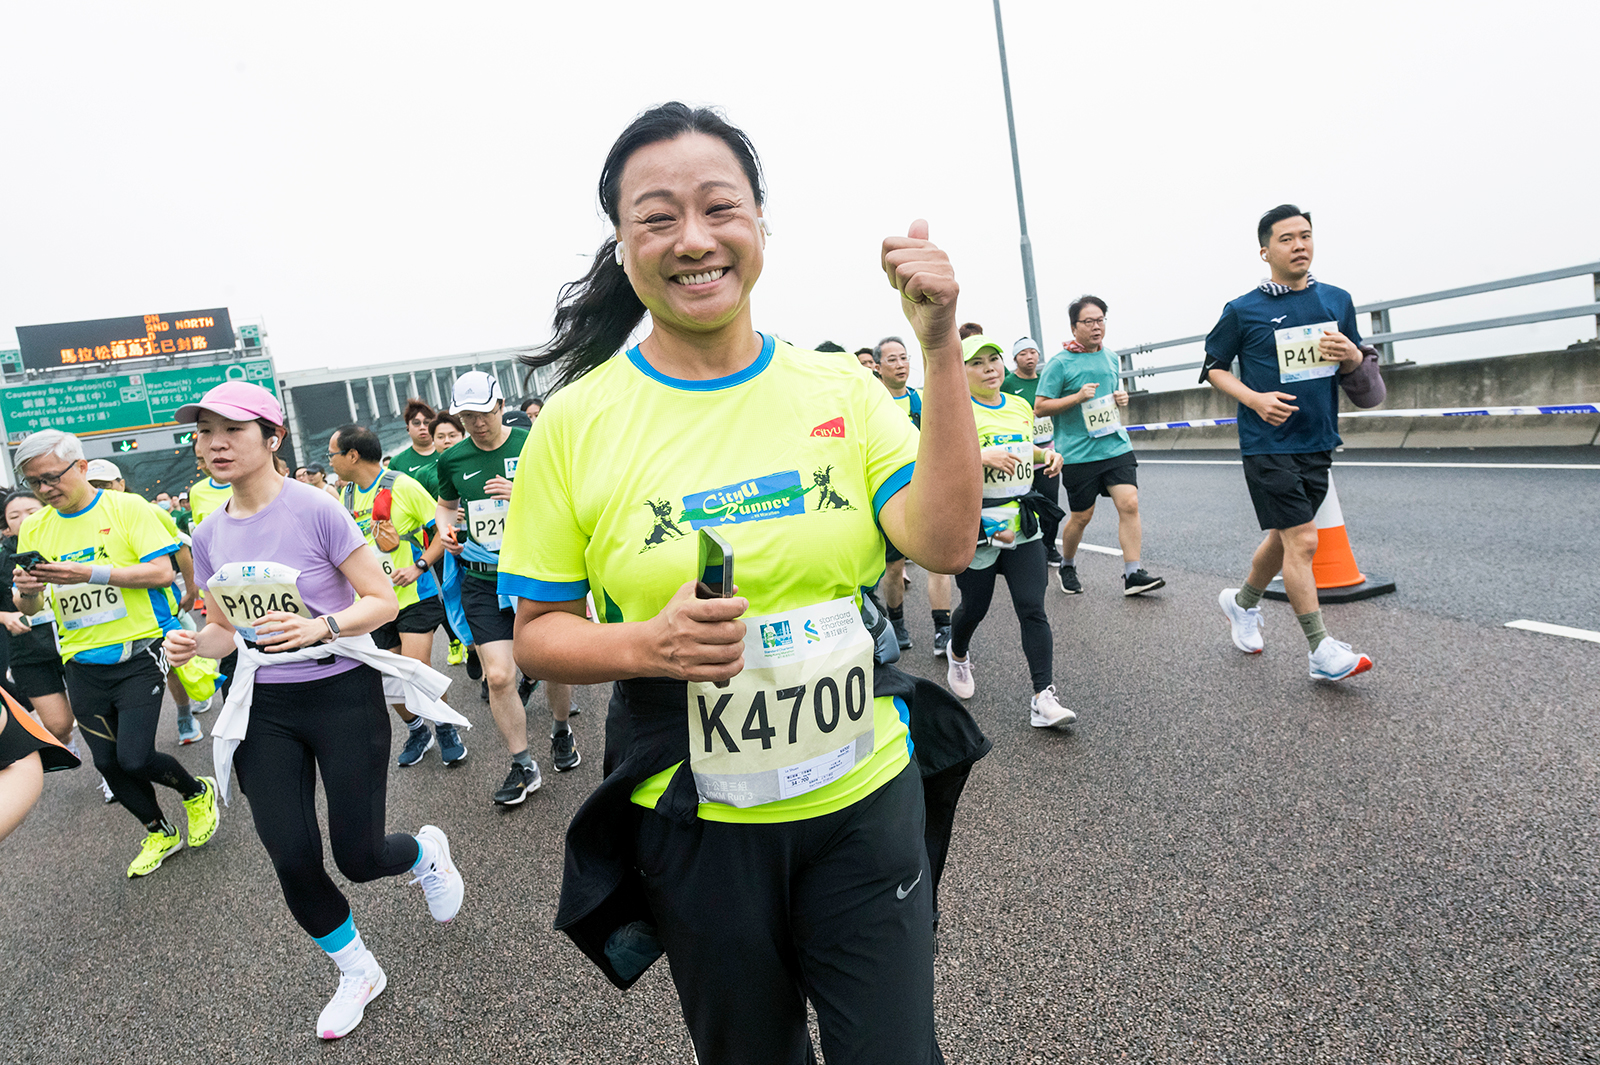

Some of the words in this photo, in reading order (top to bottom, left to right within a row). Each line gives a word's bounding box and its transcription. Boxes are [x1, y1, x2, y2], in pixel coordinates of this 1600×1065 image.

[175, 317, 215, 330] NORTH
[60, 335, 208, 364] 馬拉松港島北已封路
[5, 388, 47, 399] Causeway
[67, 380, 117, 393] Kowloon(C)
[58, 403, 97, 414] Gloucester
[813, 426, 842, 438] CityU
[703, 481, 760, 514] CityU
[720, 496, 790, 522] Runner
[60, 587, 118, 616] P2076
[221, 593, 299, 620] P1846
[819, 610, 850, 625] standard
[821, 617, 854, 630] chartered
[697, 666, 867, 753] K4700
[704, 780, 748, 792] 十公里三組
[727, 792, 745, 801] Run
[747, 791, 754, 800] 3
